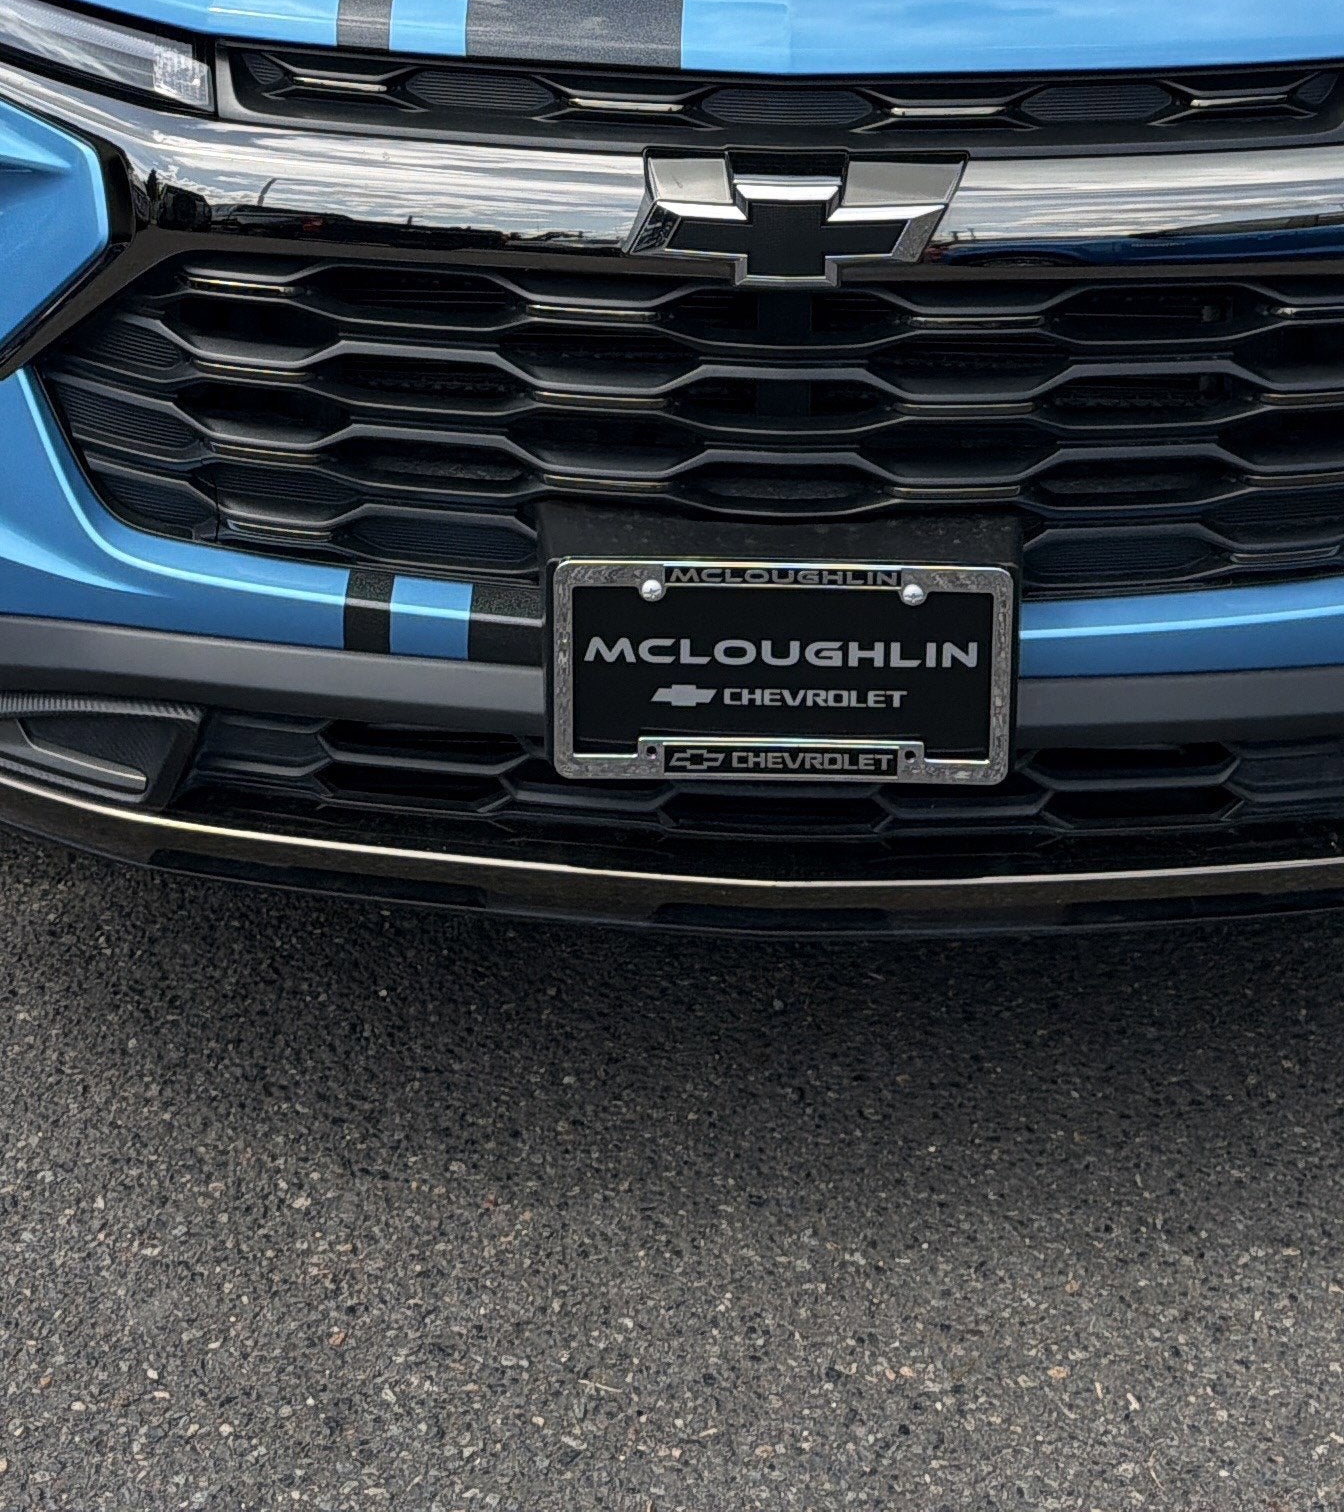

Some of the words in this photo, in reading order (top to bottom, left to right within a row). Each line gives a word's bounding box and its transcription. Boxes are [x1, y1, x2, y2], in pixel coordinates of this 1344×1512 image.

[668, 567, 899, 587] MCLOUGHLIN
[584, 636, 978, 668] MCLOUGHLIN
[723, 688, 908, 708] CHEVROLET
[731, 751, 894, 771] CHEVROLET
